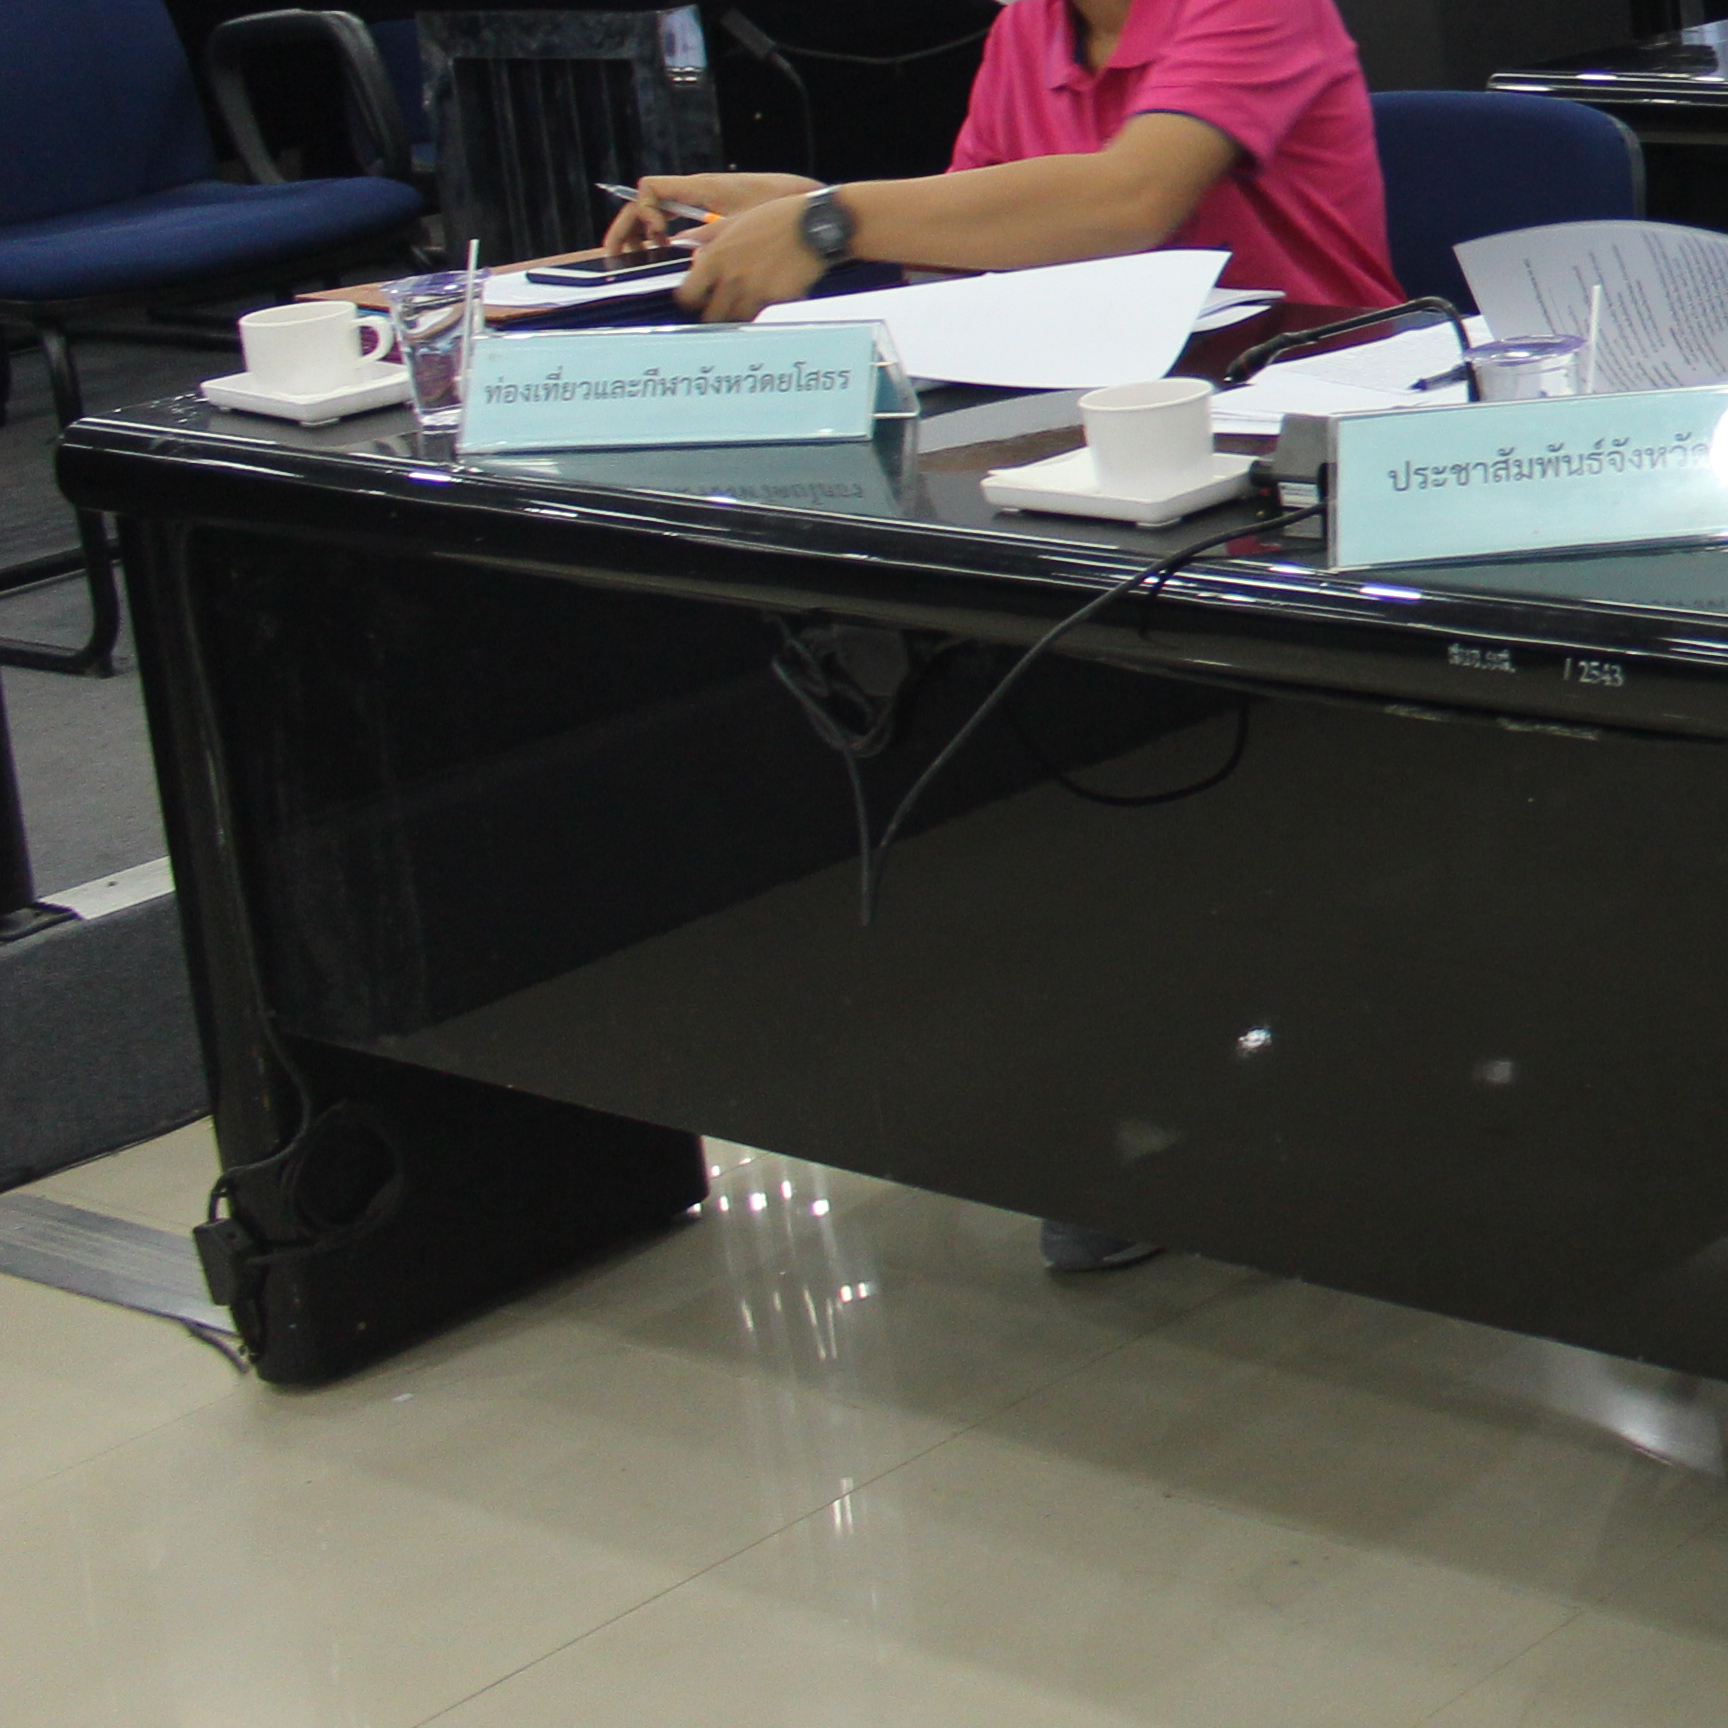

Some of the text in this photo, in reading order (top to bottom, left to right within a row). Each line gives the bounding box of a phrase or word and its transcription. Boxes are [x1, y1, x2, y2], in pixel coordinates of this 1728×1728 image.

[484, 362, 851, 405] ท่องเที่ยวและกีฬาจังหวัดยโสธร
